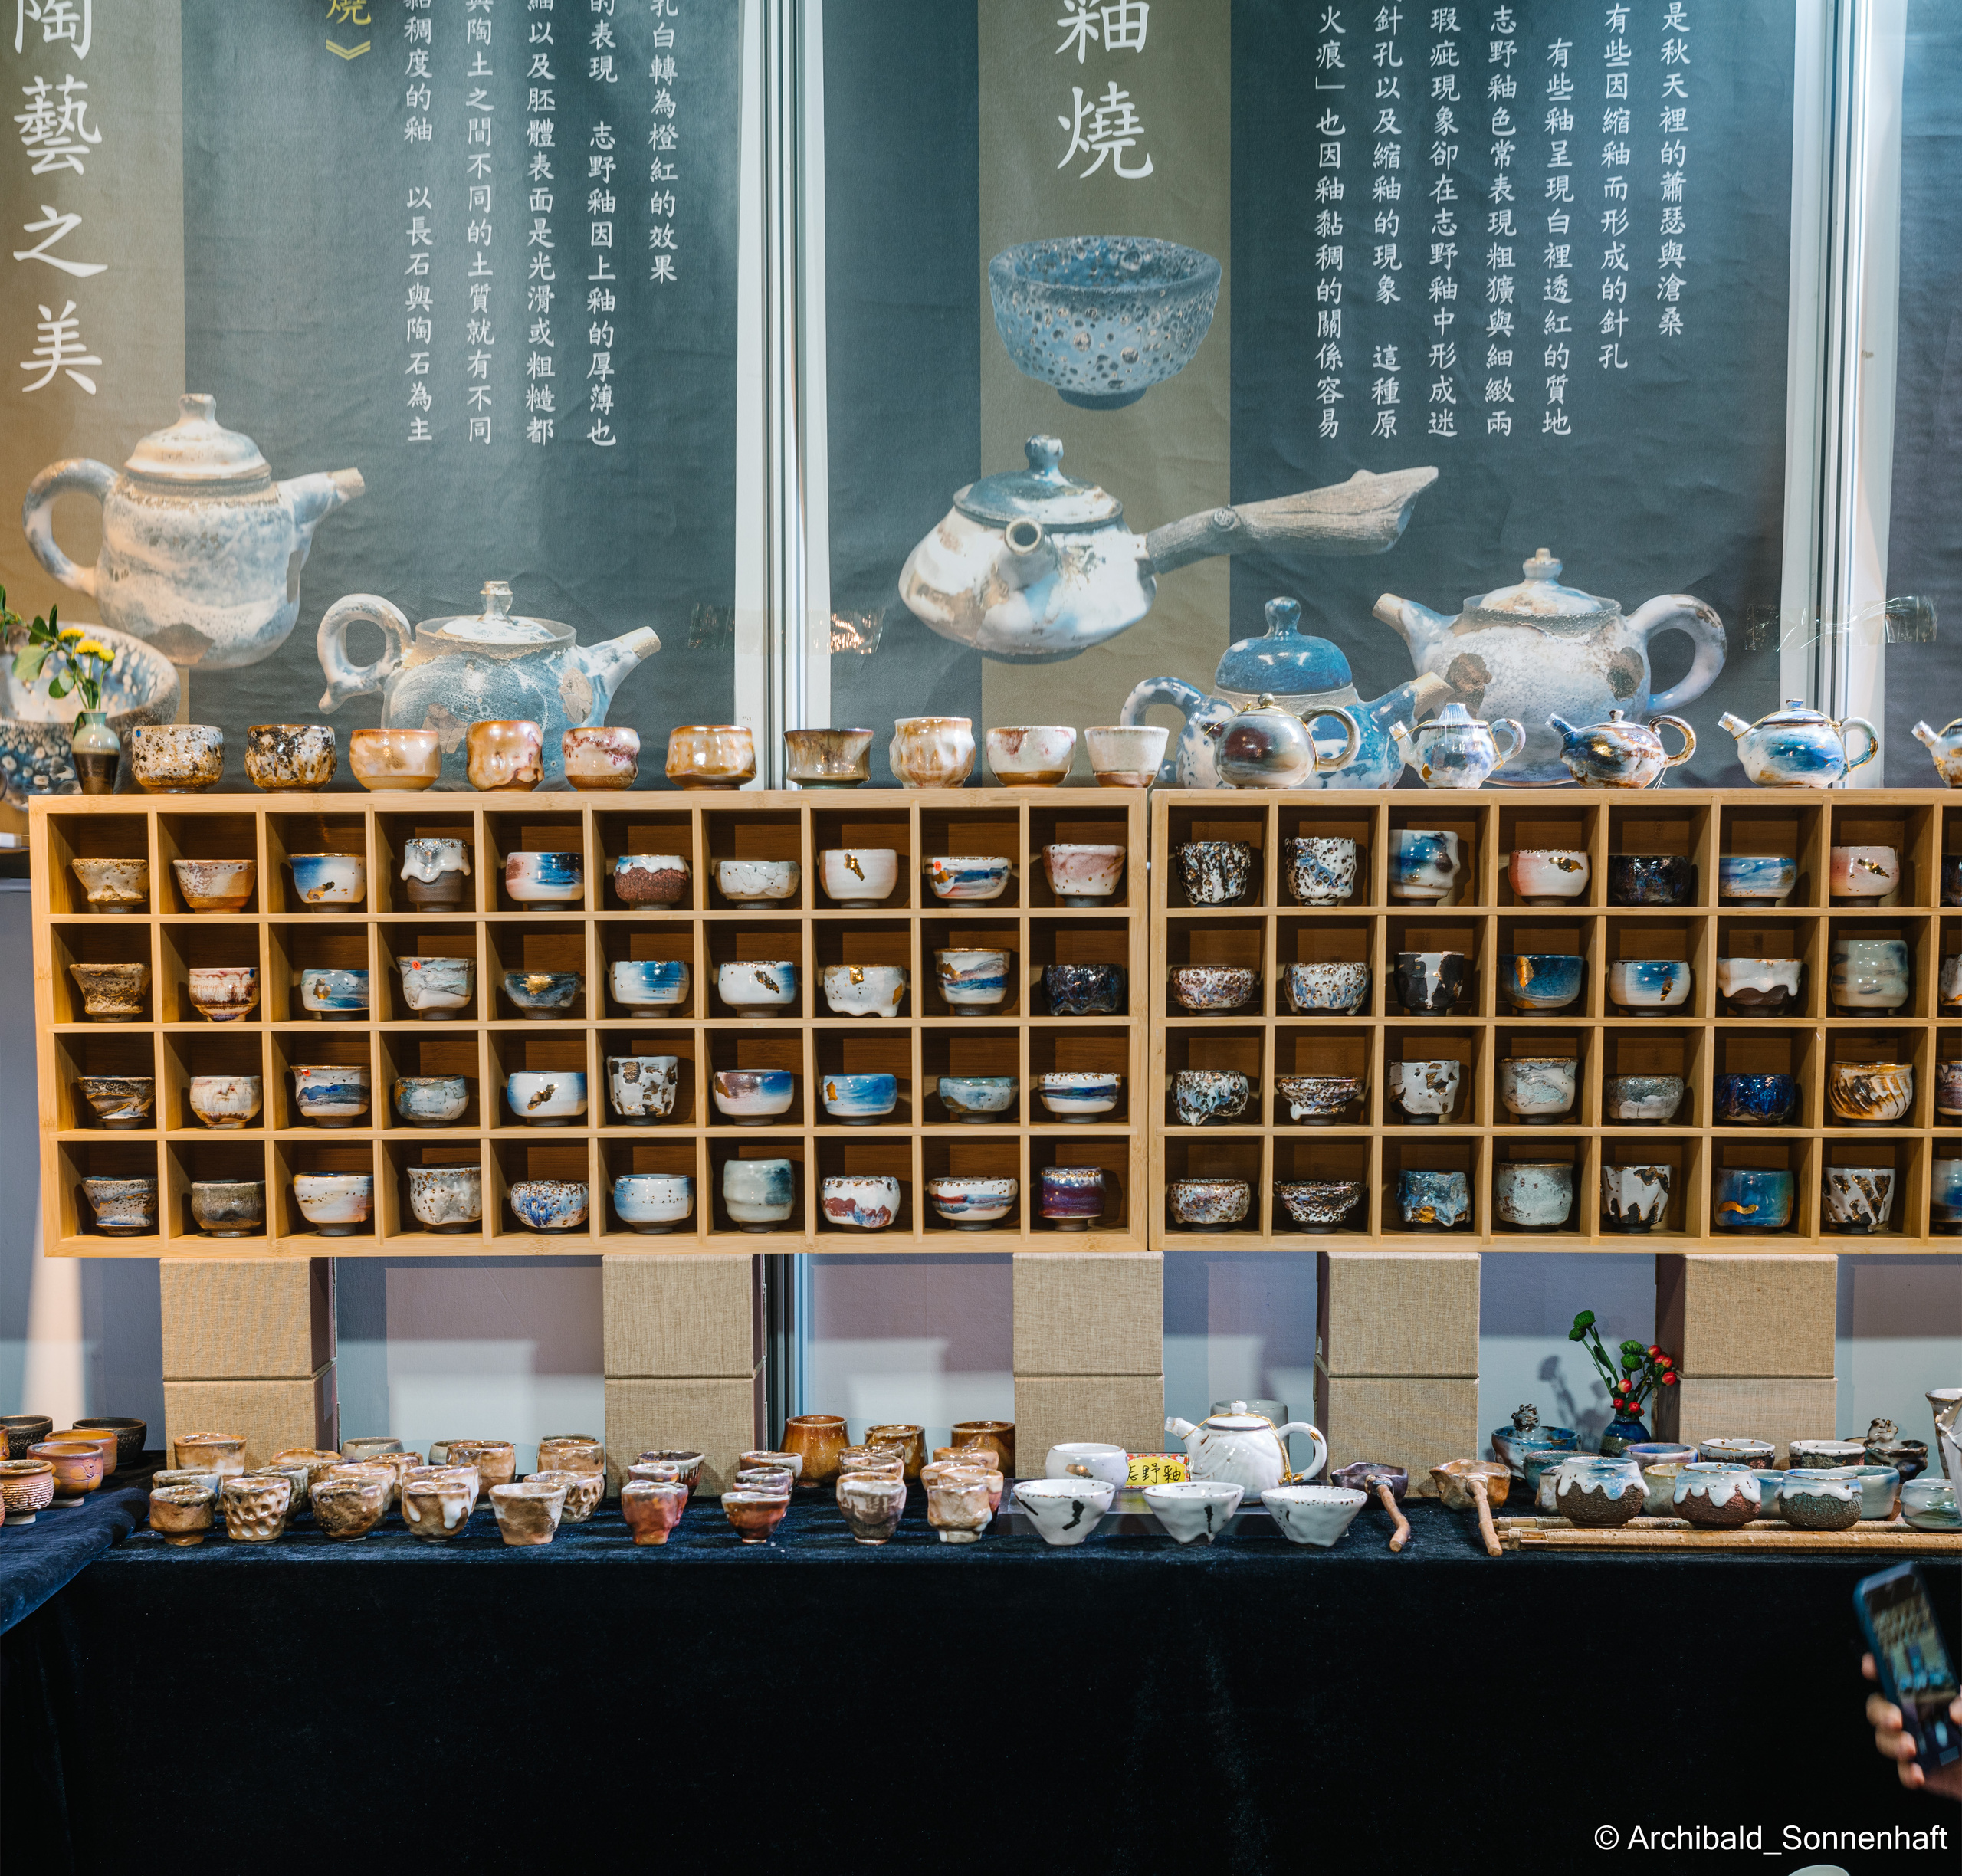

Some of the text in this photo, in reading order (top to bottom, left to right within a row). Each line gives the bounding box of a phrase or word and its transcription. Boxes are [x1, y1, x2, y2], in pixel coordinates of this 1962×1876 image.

[13, 0, 109, 395] 陶藝之美
[587, 120, 617, 448] 志野釉因上釉的厚薄也
[1055, 0, 1154, 180] 釉燒
[1314, 5, 1347, 440] 火痕」也因釉黏稠的關係容易
[1371, 5, 1403, 440] 針孔以及縮釉的現象 這種原
[1428, 7, 1462, 438] 瑕疵現象卻在志野釉中形成迷
[1485, 5, 1518, 438] 志野釉色常表現粗獷與細緻兩
[1541, 38, 1575, 436] 有些釉呈現白裡透紅的質地
[1599, 3, 1632, 369] 有些因縮釉而形成的針孔
[1656, 2, 1691, 337] 是秋天裡的蕭瑟與滄桑
[405, 187, 434, 442] 以長石與陶石為主
